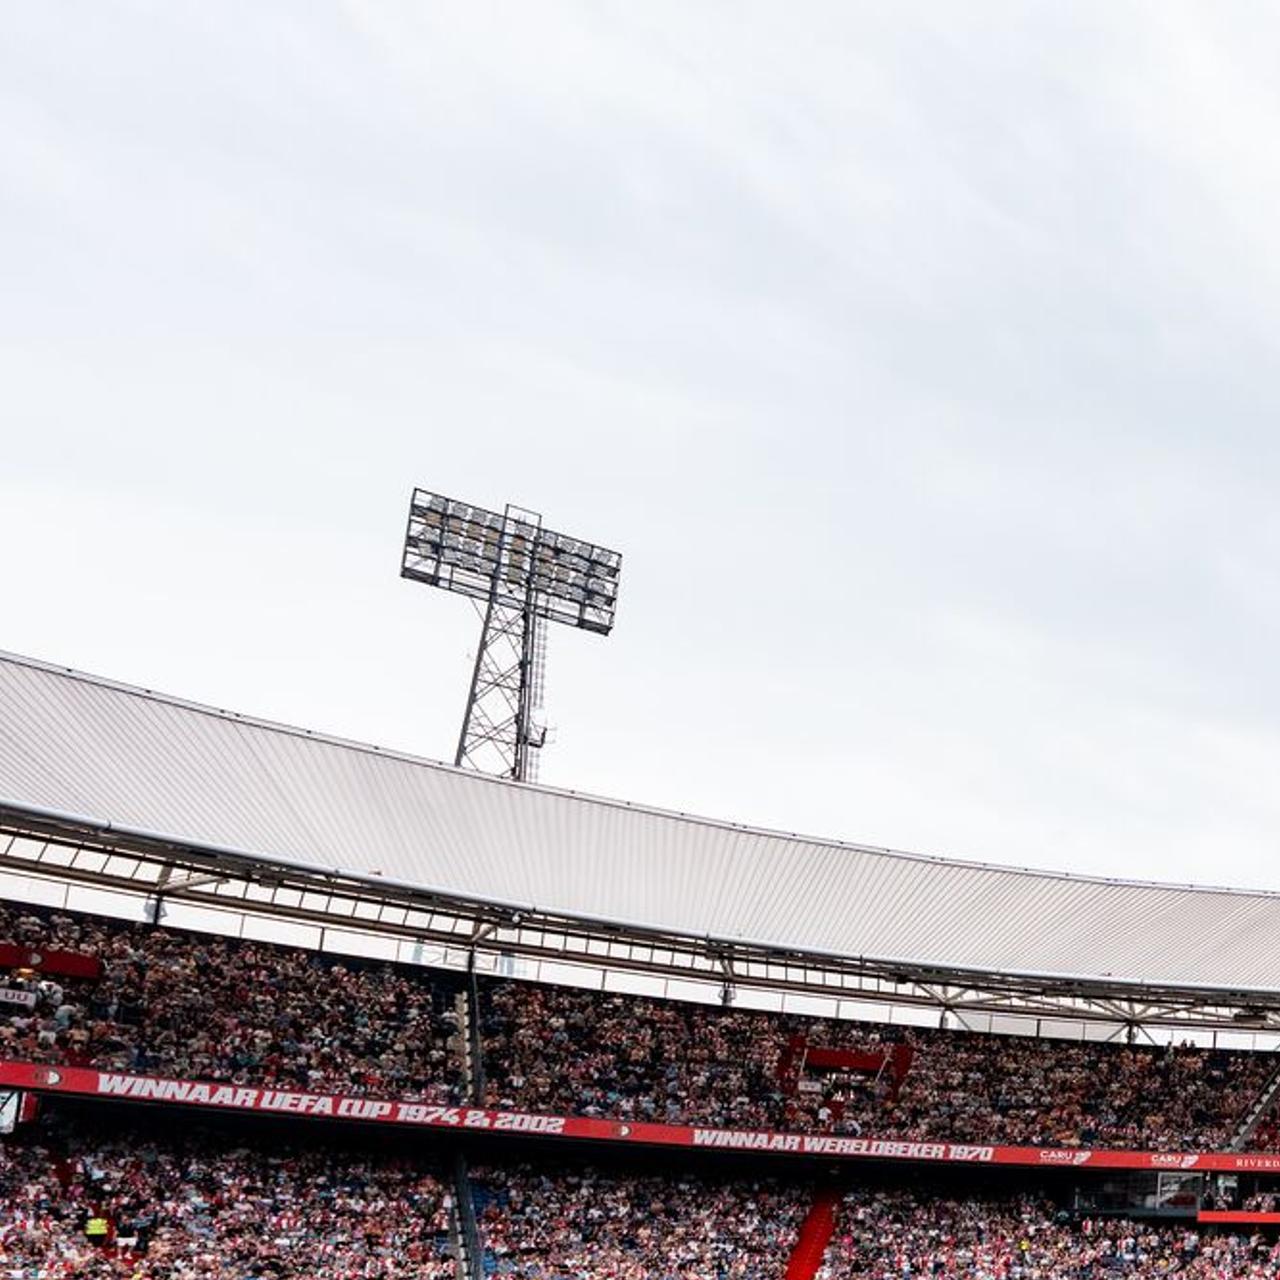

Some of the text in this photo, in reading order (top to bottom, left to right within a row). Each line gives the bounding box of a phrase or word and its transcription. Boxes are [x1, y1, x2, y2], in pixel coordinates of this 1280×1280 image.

[98, 1073, 565, 1133] WINNAAR UEFA CUP 1974 & 2002
[693, 1129, 994, 1162] WINNAAR WERELDBEKER 1970
[1040, 1150, 1073, 1161] CARU
[1151, 1154, 1182, 1164] CARU
